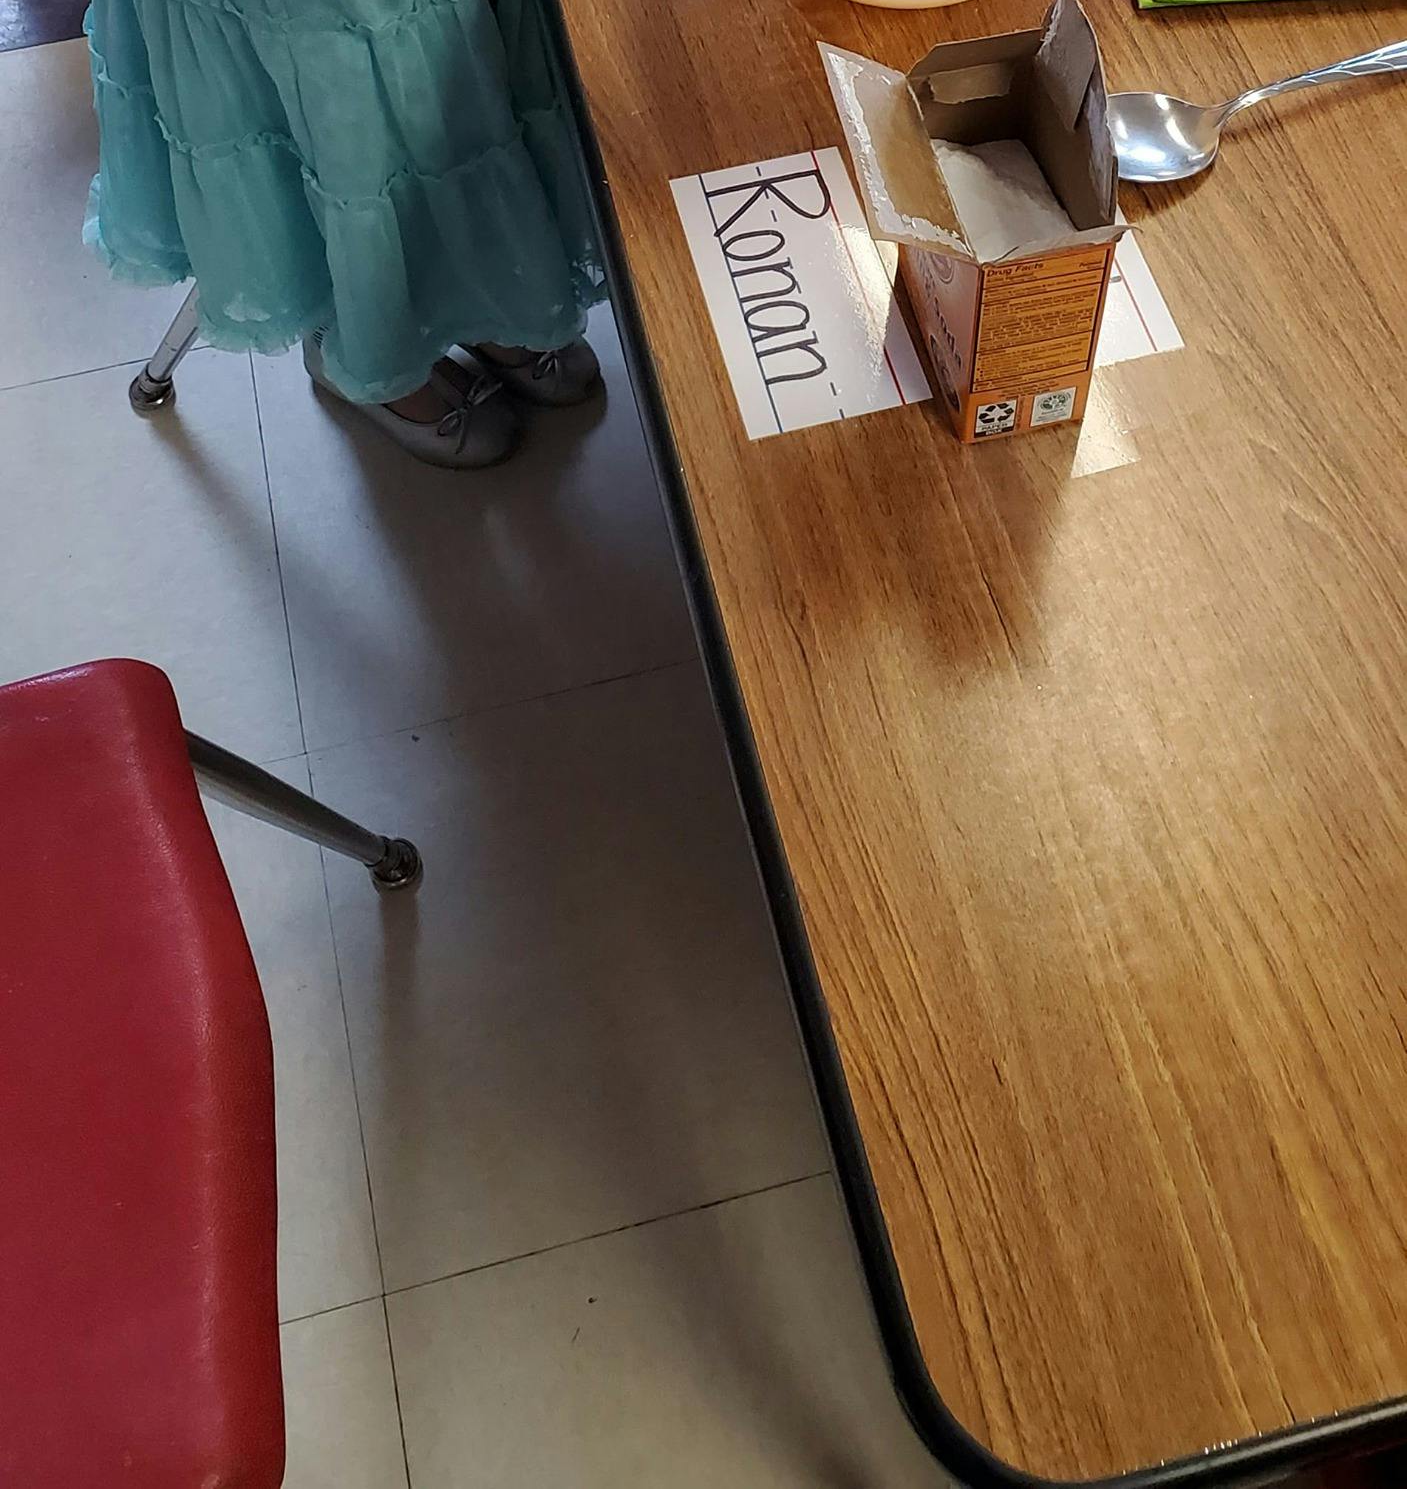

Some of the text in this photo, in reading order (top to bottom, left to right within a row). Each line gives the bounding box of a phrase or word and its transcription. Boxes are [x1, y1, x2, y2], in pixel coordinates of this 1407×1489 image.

[705, 168, 831, 386] Ronan
[986, 263, 1044, 277] Drug Facts
